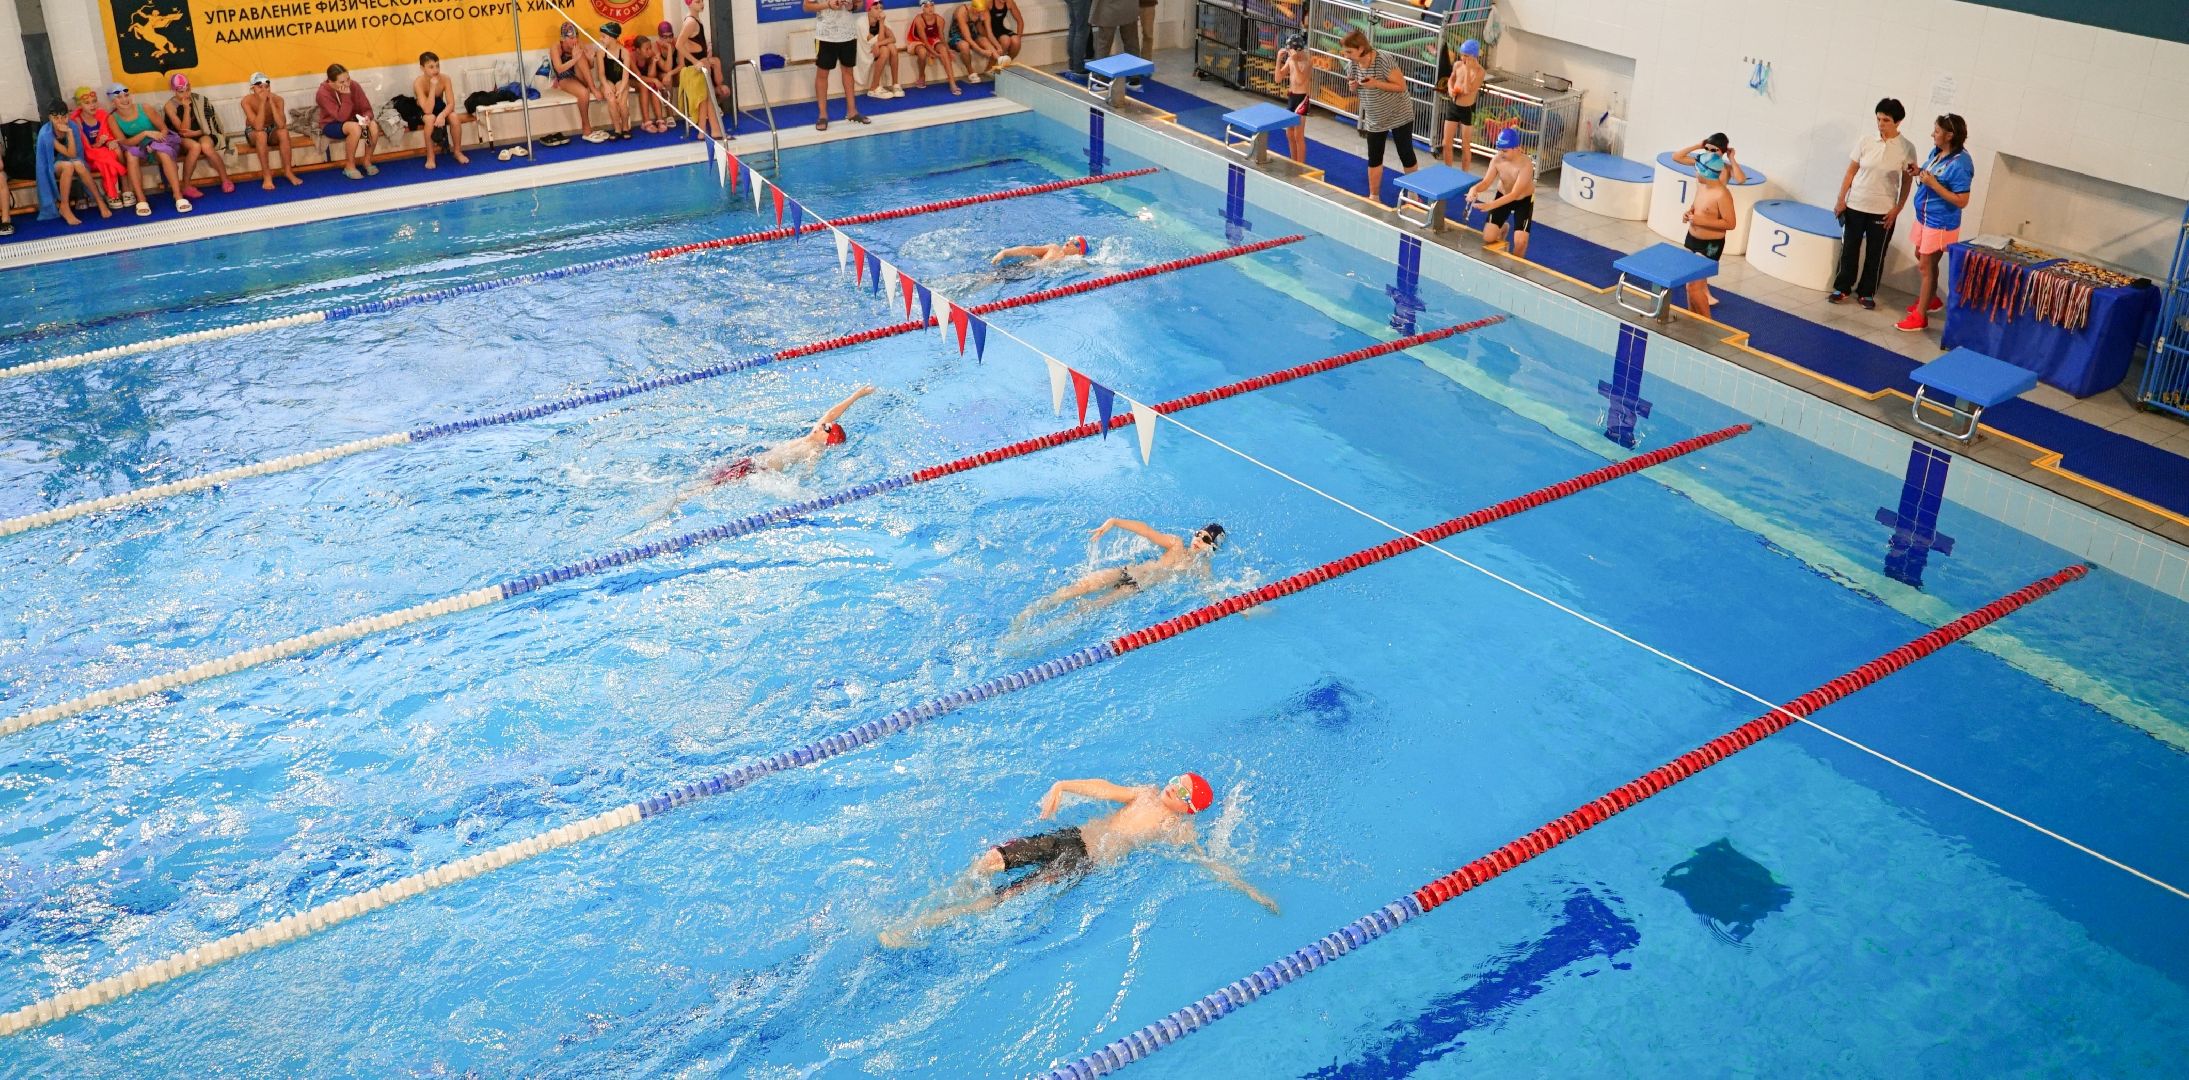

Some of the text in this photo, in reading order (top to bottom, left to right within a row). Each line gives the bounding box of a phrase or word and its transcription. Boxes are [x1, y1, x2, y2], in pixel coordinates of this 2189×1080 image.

[204, 0, 422, 25] УПРАВЛЕНИЕ ФИЗИЧЕСК
[215, 18, 357, 44] АДМИНИСТРАЦИИ
[361, 7, 465, 29] ГОРОДСКОГО
[1579, 176, 1595, 200] 3
[1677, 180, 1687, 204] 1
[1771, 229, 1790, 258] 2
